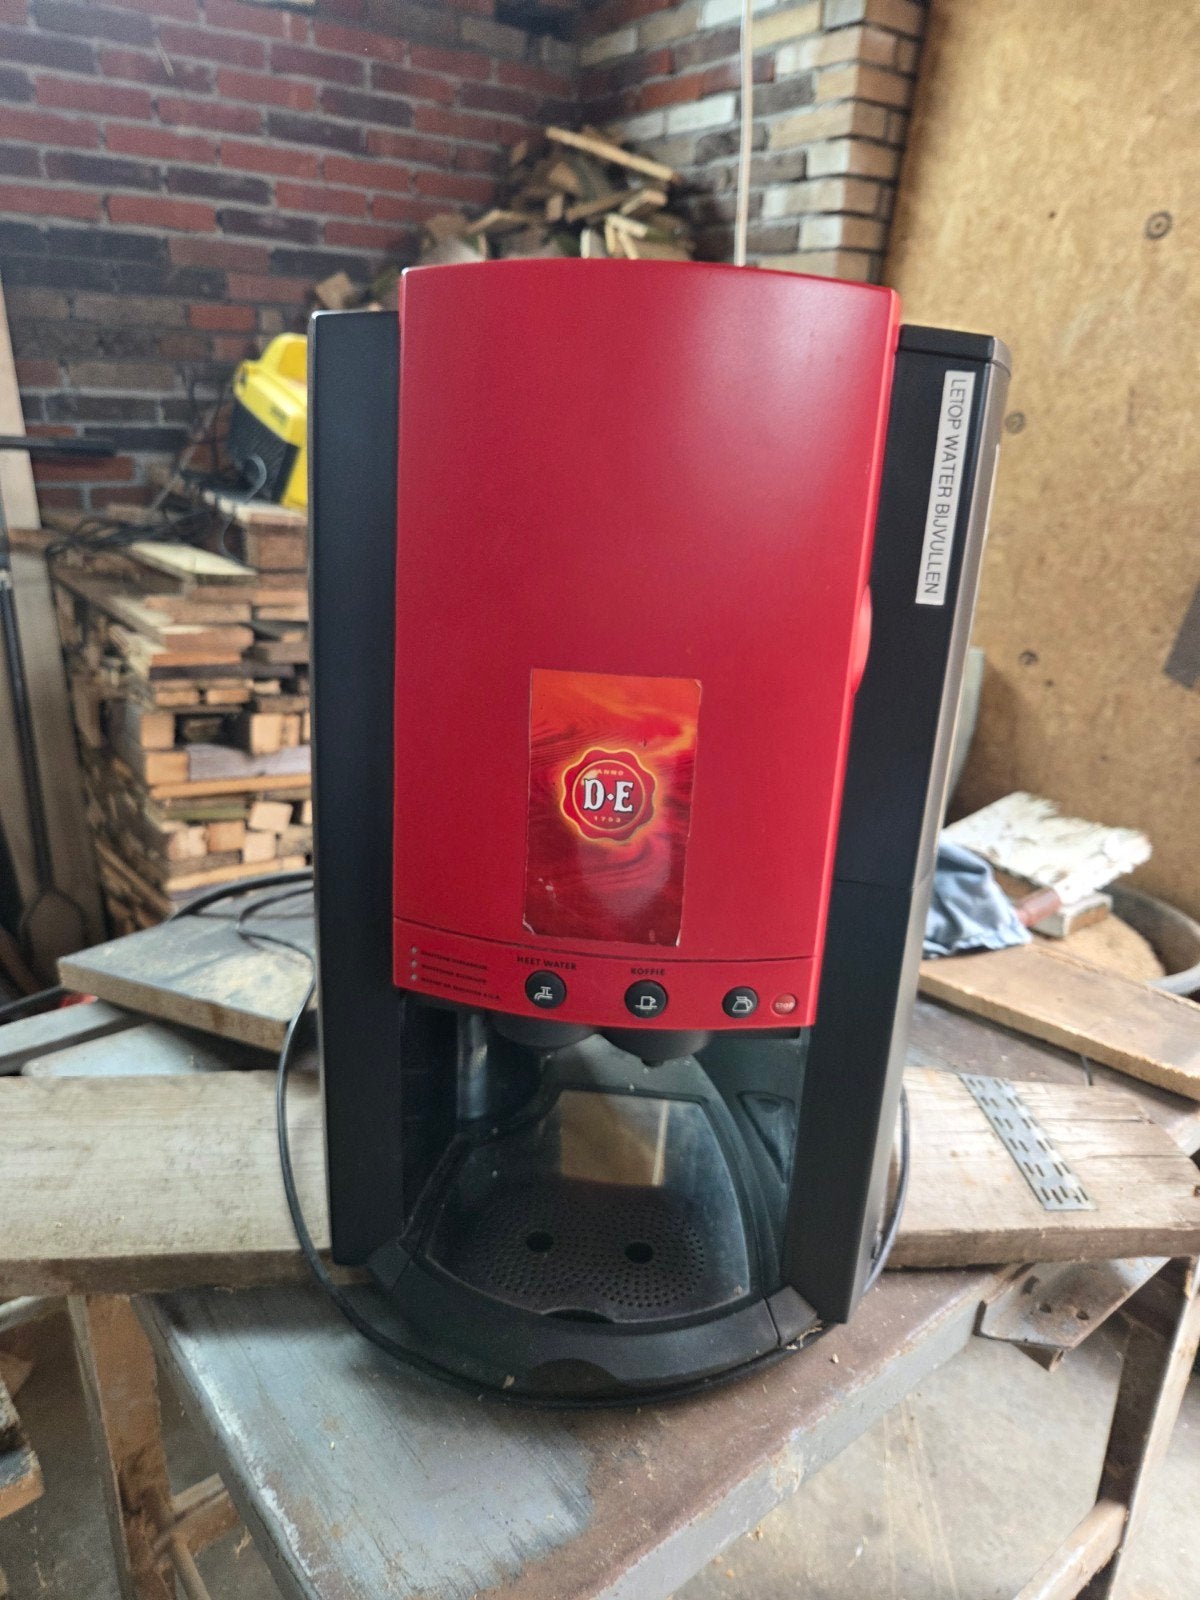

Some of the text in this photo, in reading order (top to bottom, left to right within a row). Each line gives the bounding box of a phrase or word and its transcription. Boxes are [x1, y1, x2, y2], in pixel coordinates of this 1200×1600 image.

[924, 378, 967, 595] LETOP WATER BIJVULLEN
[517, 956, 577, 971] HEET WATER
[630, 967, 666, 976] KOFFIE
[775, 1001, 796, 1009] STOP
